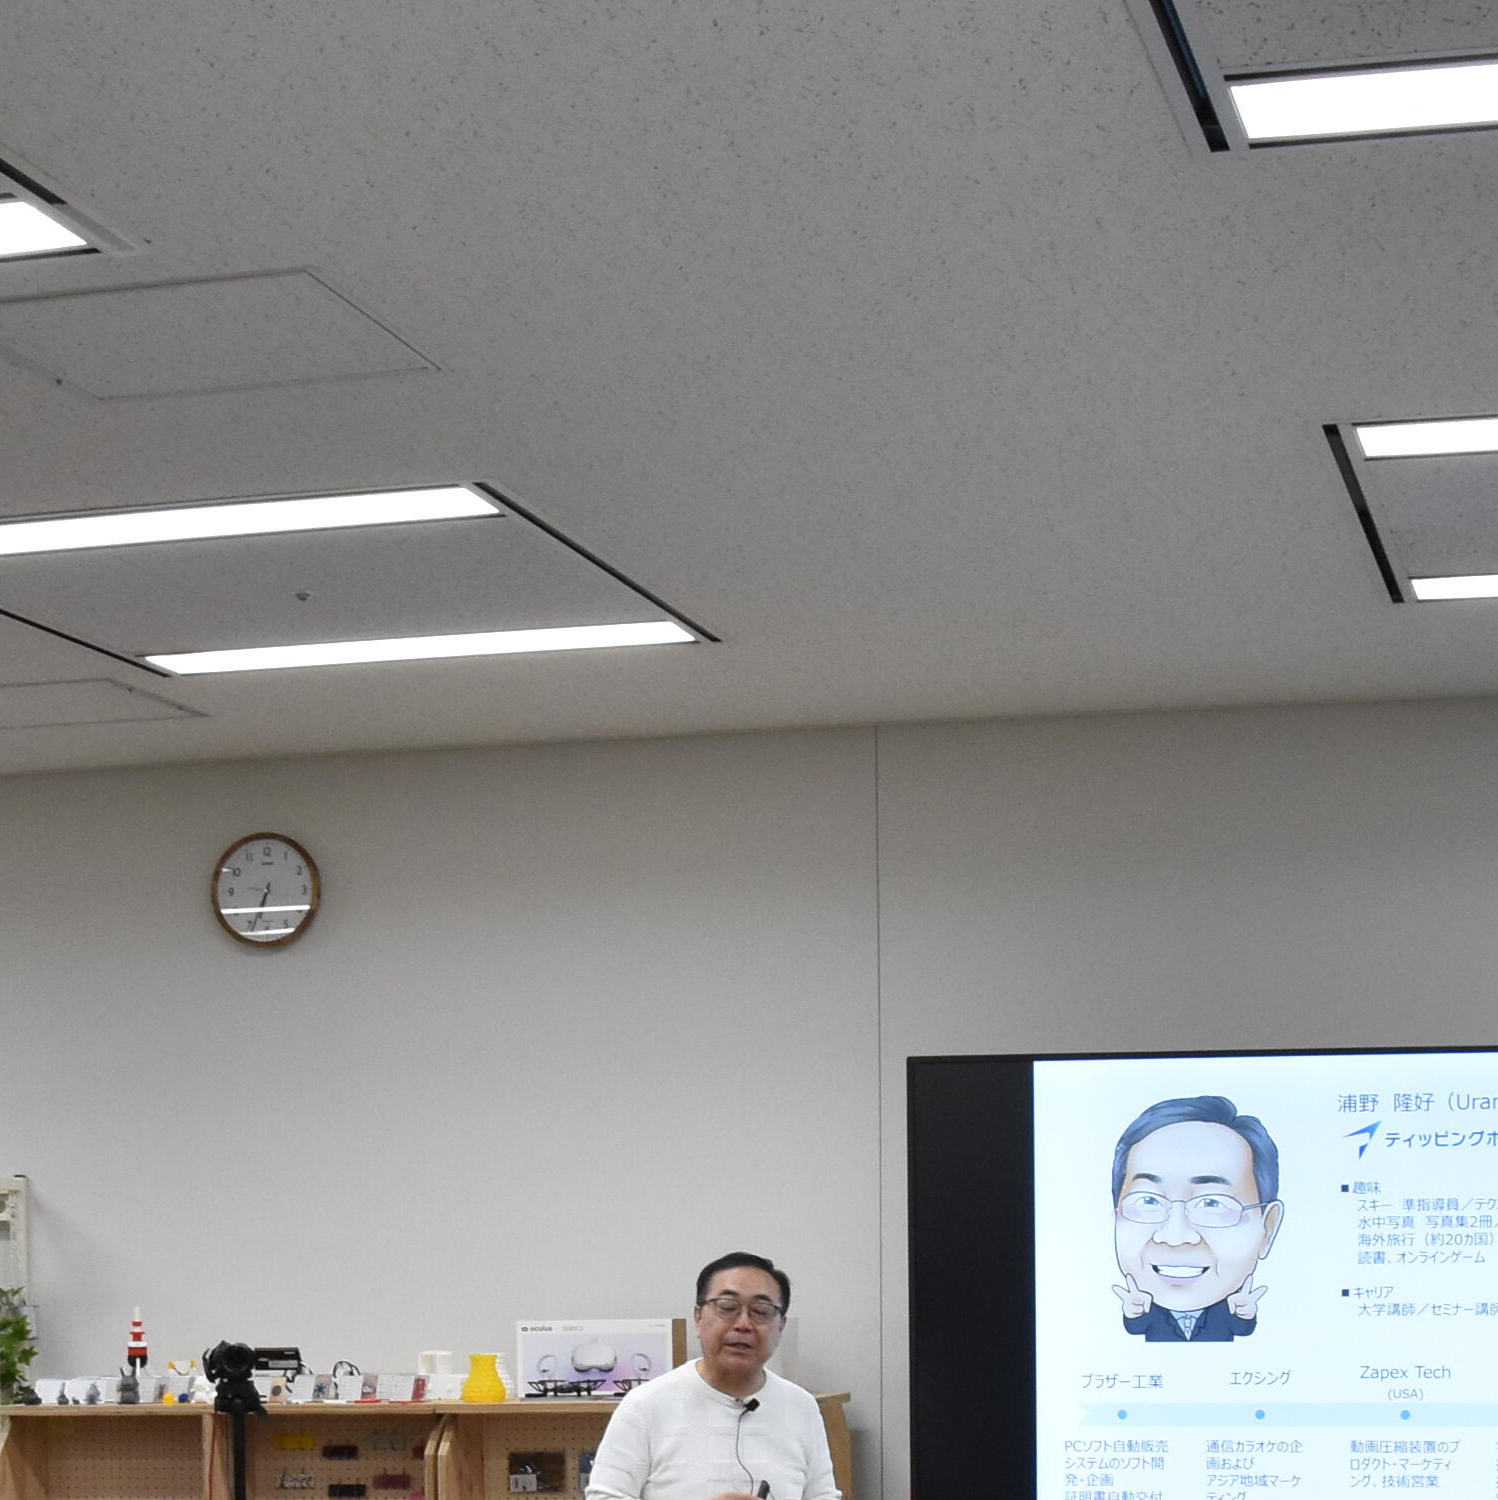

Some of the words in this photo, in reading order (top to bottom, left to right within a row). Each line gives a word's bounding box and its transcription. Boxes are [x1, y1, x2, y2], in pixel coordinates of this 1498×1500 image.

[1337, 1093, 1379, 1113] 浦野
[1393, 1092, 1434, 1112] 隆好
[1352, 1182, 1381, 1194] 趣味
[1358, 1199, 1391, 1212] スキー
[1357, 1216, 1415, 1230] 水中写真
[1357, 1250, 1486, 1265] 読書、オンラインゲーム
[1353, 1286, 1394, 1300] キャリア
[1229, 1370, 1291, 1386] エクシング
[1360, 1365, 1409, 1382] Zapex
[1415, 1364, 1451, 1380] Tech
[1081, 1373, 1165, 1390] ブラザー工業
[1387, 1388, 1424, 1402] (USA)
[1065, 1440, 1169, 1454] PCソフト自動販売
[1206, 1440, 1303, 1454] 通信カラオケの企
[1065, 1456, 1165, 1470] システムのソフト開
[1207, 1456, 1253, 1470] 画および
[1065, 1473, 1114, 1488] 発・企画
[1207, 1474, 1301, 1488] アジア地域マーケ
